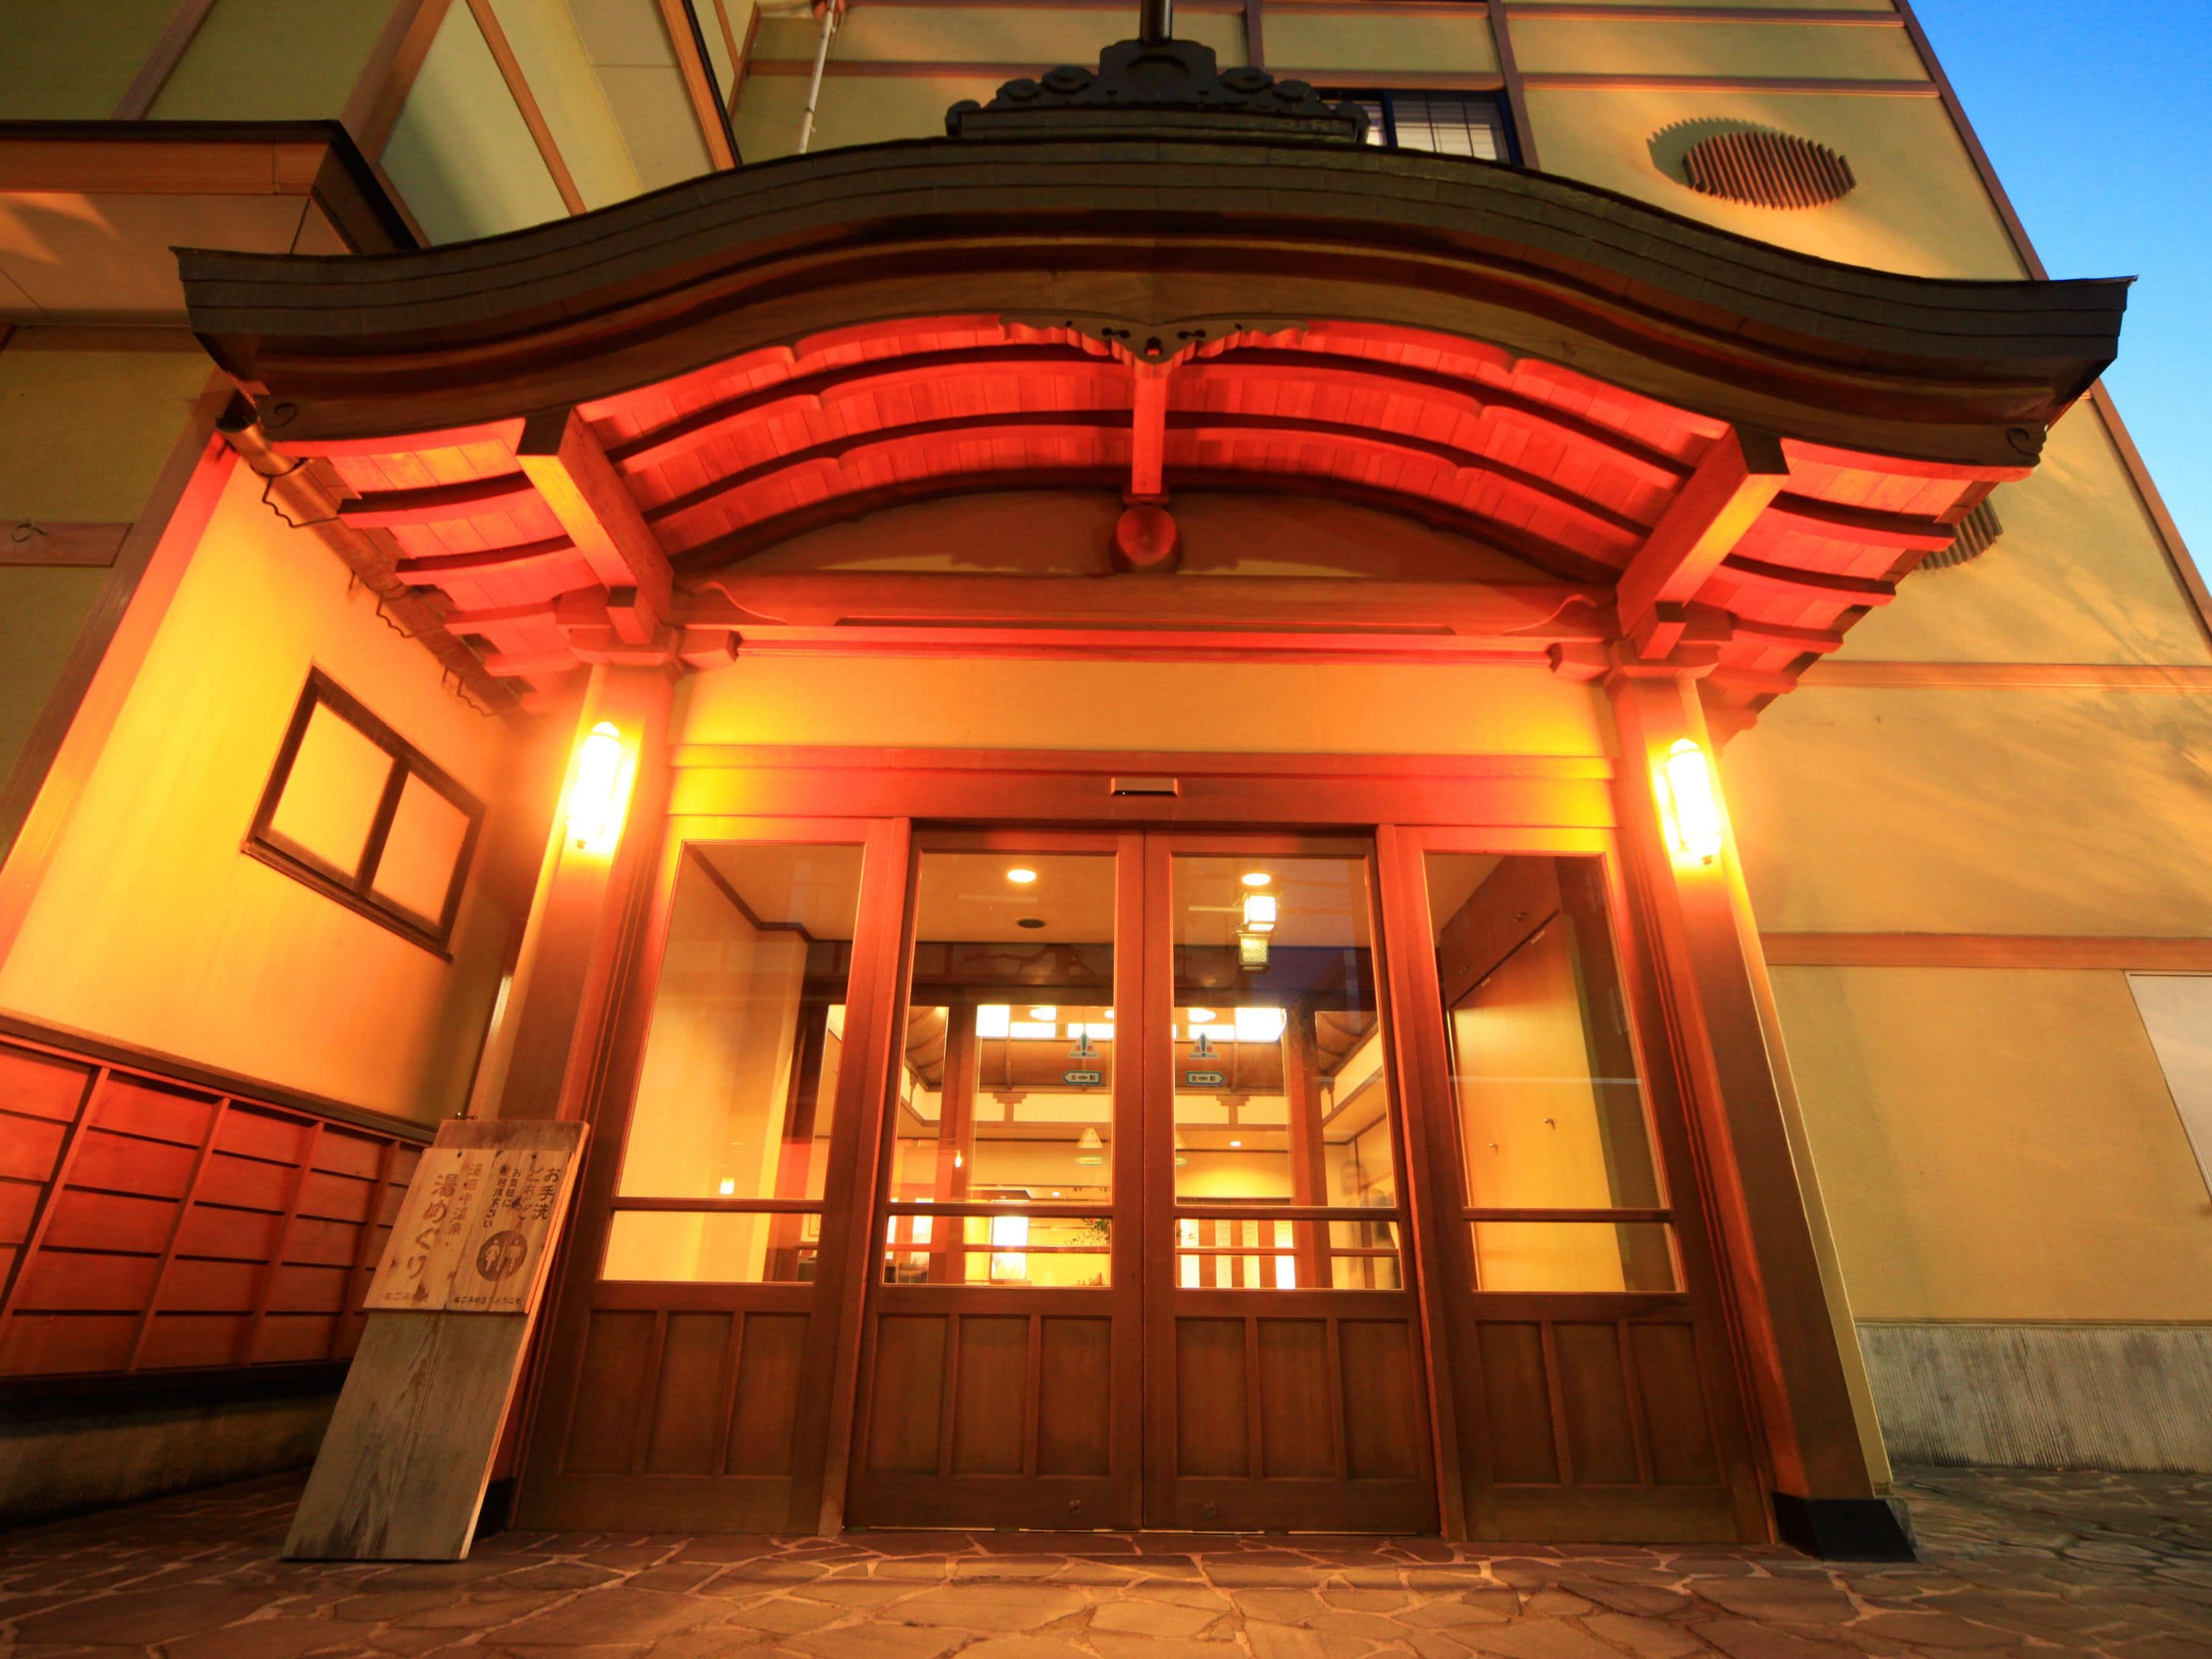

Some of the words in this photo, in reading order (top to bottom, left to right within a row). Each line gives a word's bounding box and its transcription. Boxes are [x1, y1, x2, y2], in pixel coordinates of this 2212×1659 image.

[406, 1173, 459, 1280] 湯めぐり
[531, 1167, 561, 1220] お手洗
